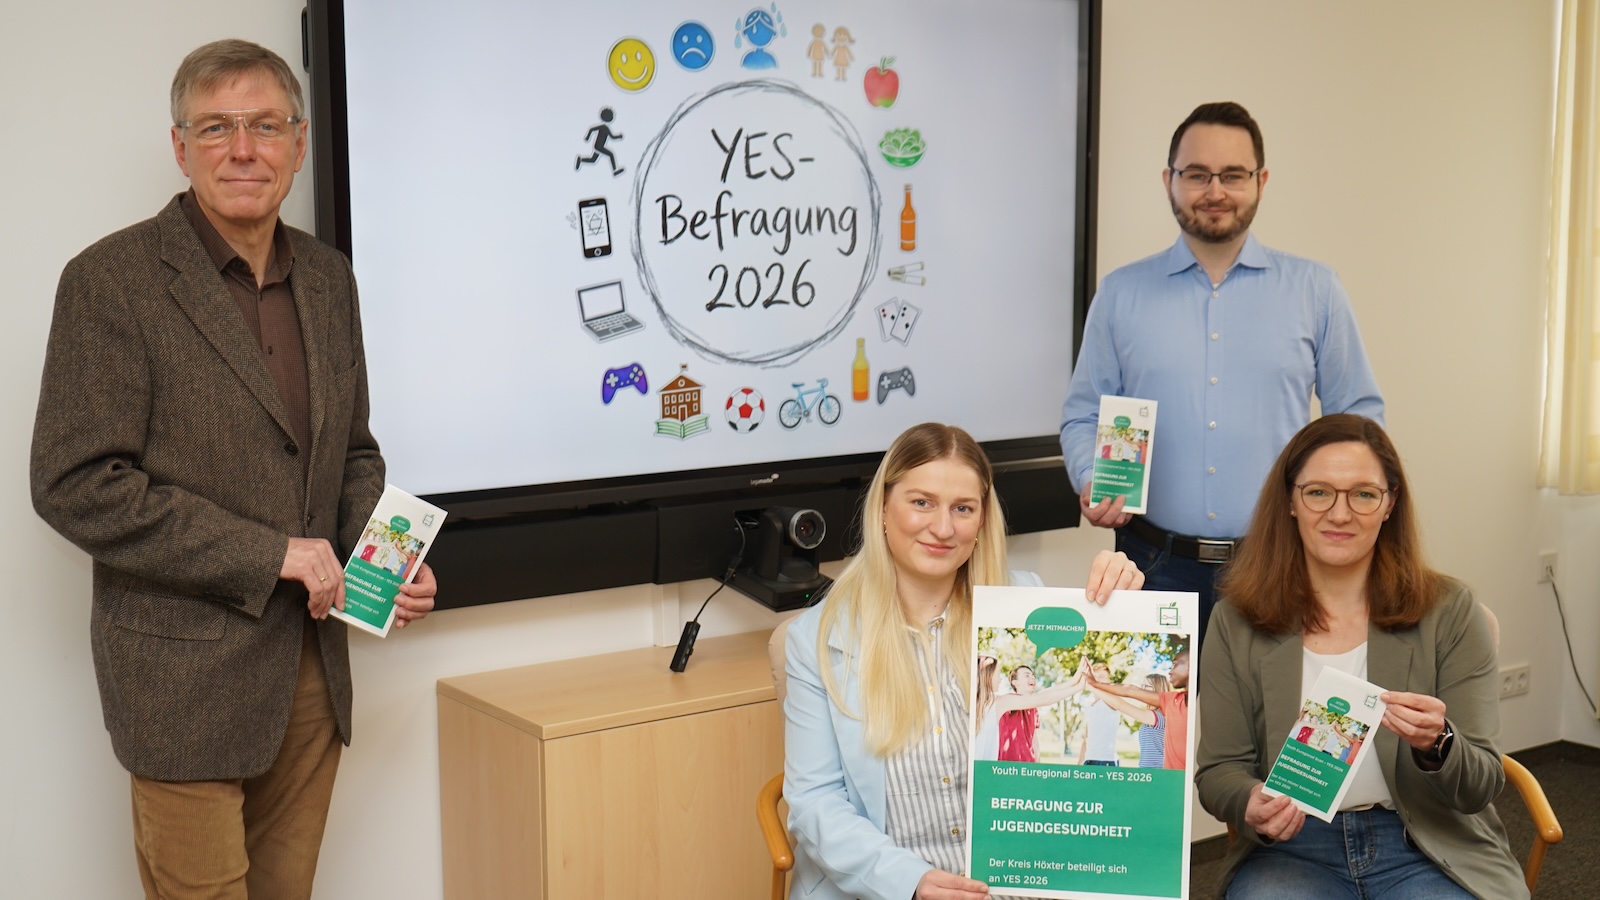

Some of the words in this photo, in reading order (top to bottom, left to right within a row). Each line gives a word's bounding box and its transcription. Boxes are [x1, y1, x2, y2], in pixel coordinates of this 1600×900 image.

[711, 128, 815, 183] YES-
[656, 190, 858, 256] Befragung
[706, 259, 815, 312] 2026
[345, 573, 372, 588] BEFRAGUNG
[1280, 754, 1311, 771] BEFRAGUNG
[1311, 767, 1322, 775] ZUR
[992, 766, 1018, 776] Youth
[1021, 767, 1070, 779] Euregional
[1074, 770, 1096, 780] Scan
[1106, 772, 1124, 781] YES
[1127, 773, 1152, 782] 2026
[1277, 761, 1329, 787] JUGENDGESUNDHEIT
[991, 798, 1072, 813] BEFRAGUNG
[1076, 802, 1103, 814] ZUR
[990, 820, 1132, 838] JUGENDGESUNDHEIT
[989, 858, 1005, 867] Der
[1008, 859, 1031, 869] Kreis
[1034, 861, 1064, 871] Höxter
[1068, 862, 1105, 874] beteiligt
[1108, 864, 1127, 873] sich
[1003, 875, 1020, 884] YES
[1024, 876, 1048, 885] 2026
